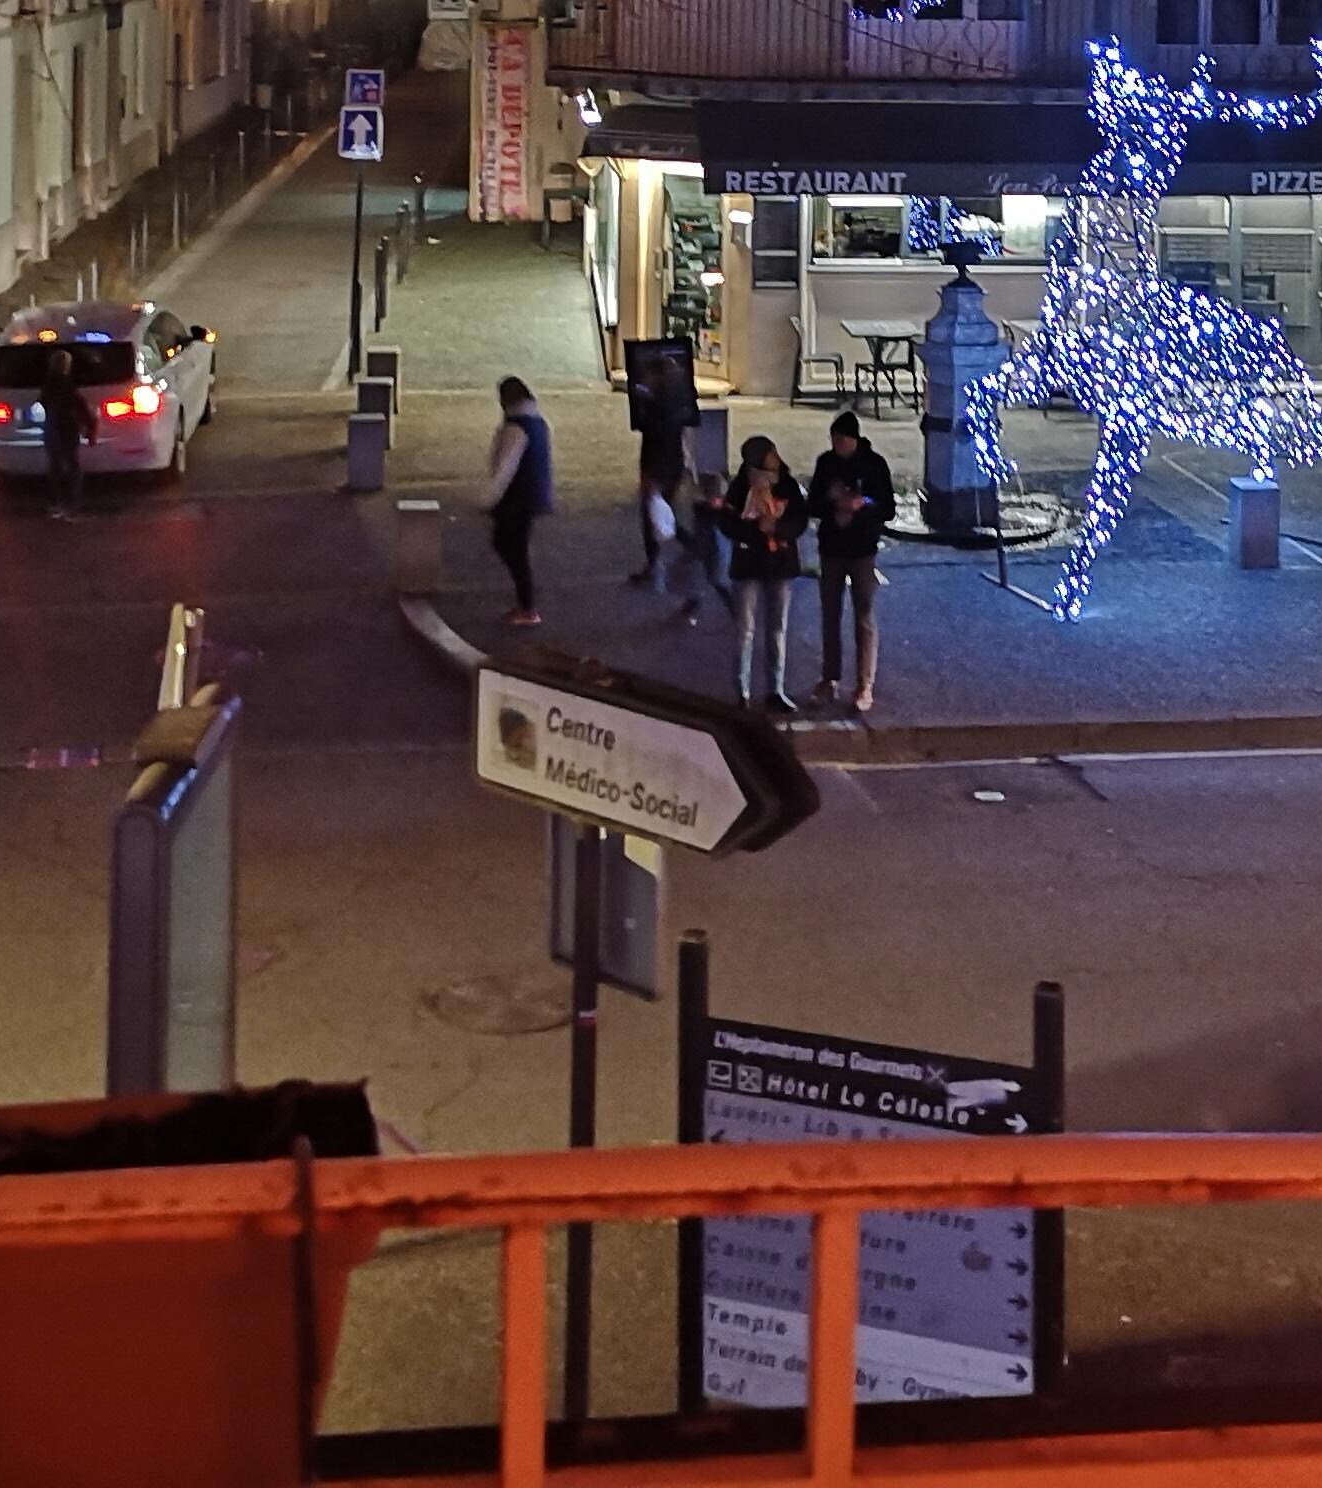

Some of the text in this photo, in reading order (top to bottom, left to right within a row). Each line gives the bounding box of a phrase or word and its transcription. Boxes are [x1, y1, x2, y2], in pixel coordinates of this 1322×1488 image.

[724, 171, 908, 194] RESTAURANT
[546, 706, 616, 751] Centre
[544, 756, 699, 827] Médico-Social
[766, 1073, 829, 1102] Hôtel
[839, 1084, 866, 1109] Le
[708, 1302, 788, 1337] Temple
[708, 1337, 776, 1369] Terrain
